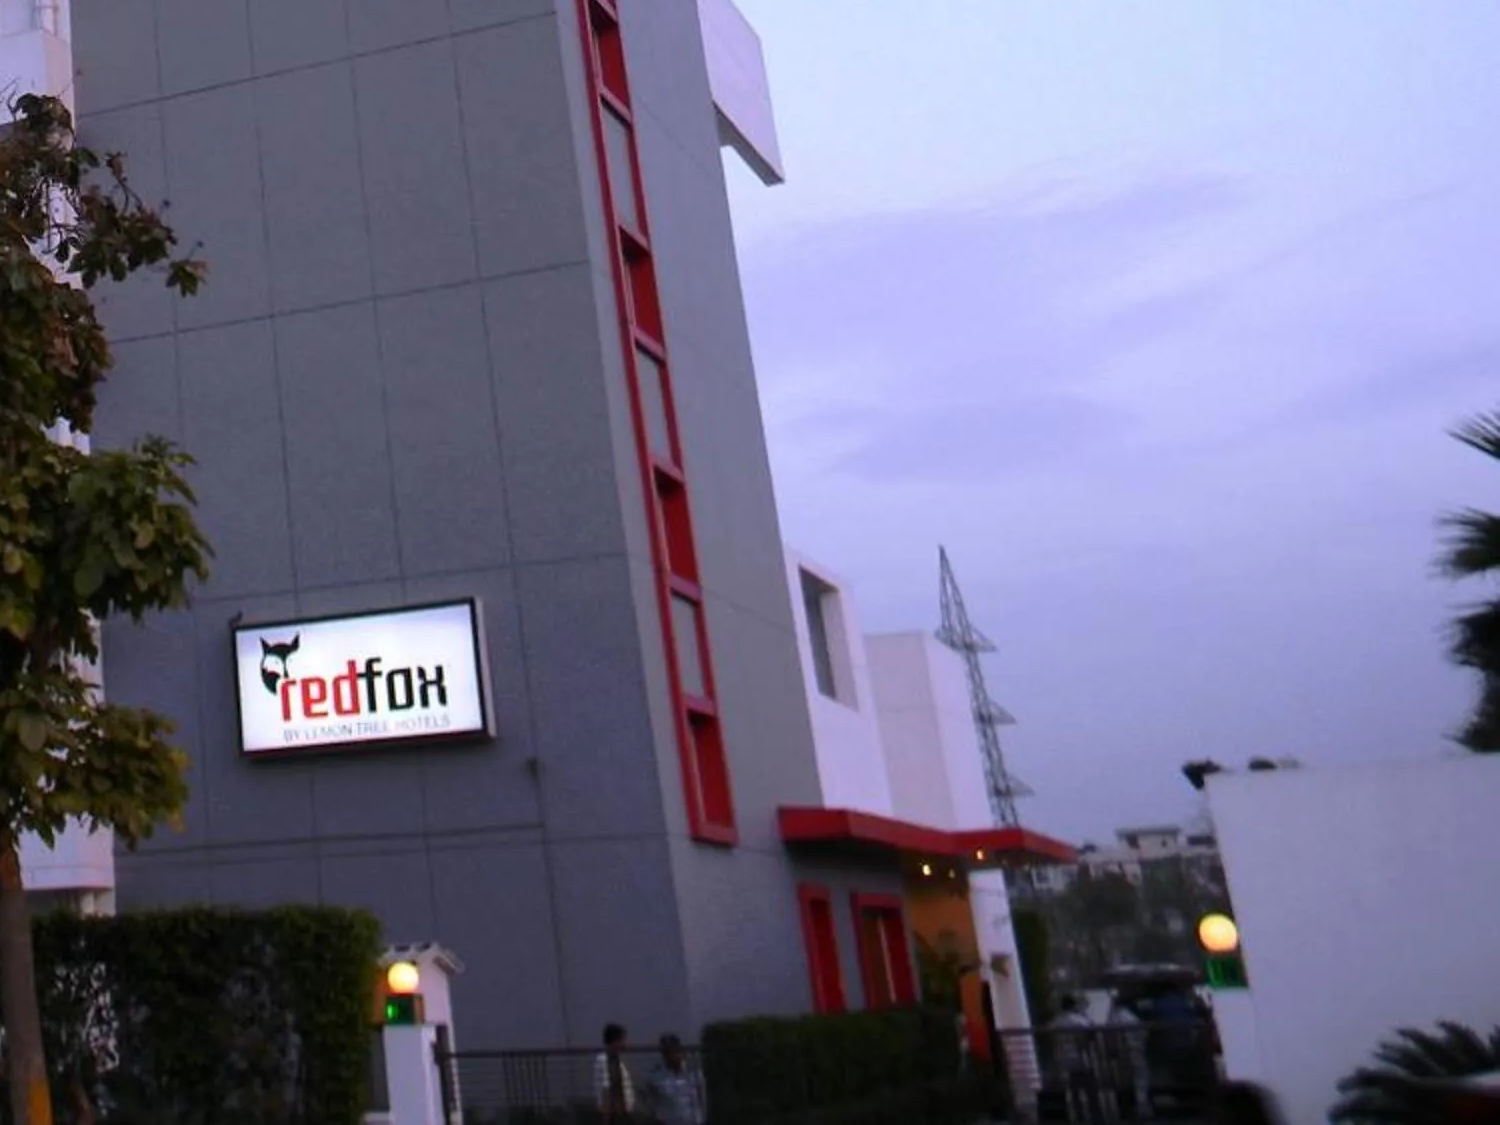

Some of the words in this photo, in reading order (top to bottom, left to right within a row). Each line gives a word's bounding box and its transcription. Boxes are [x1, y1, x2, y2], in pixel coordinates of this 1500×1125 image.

[280, 657, 447, 722] redfox
[283, 727, 301, 742] BY
[304, 723, 352, 740] LEMON
[356, 720, 389, 736] TREE
[395, 714, 451, 732] HOTELS
